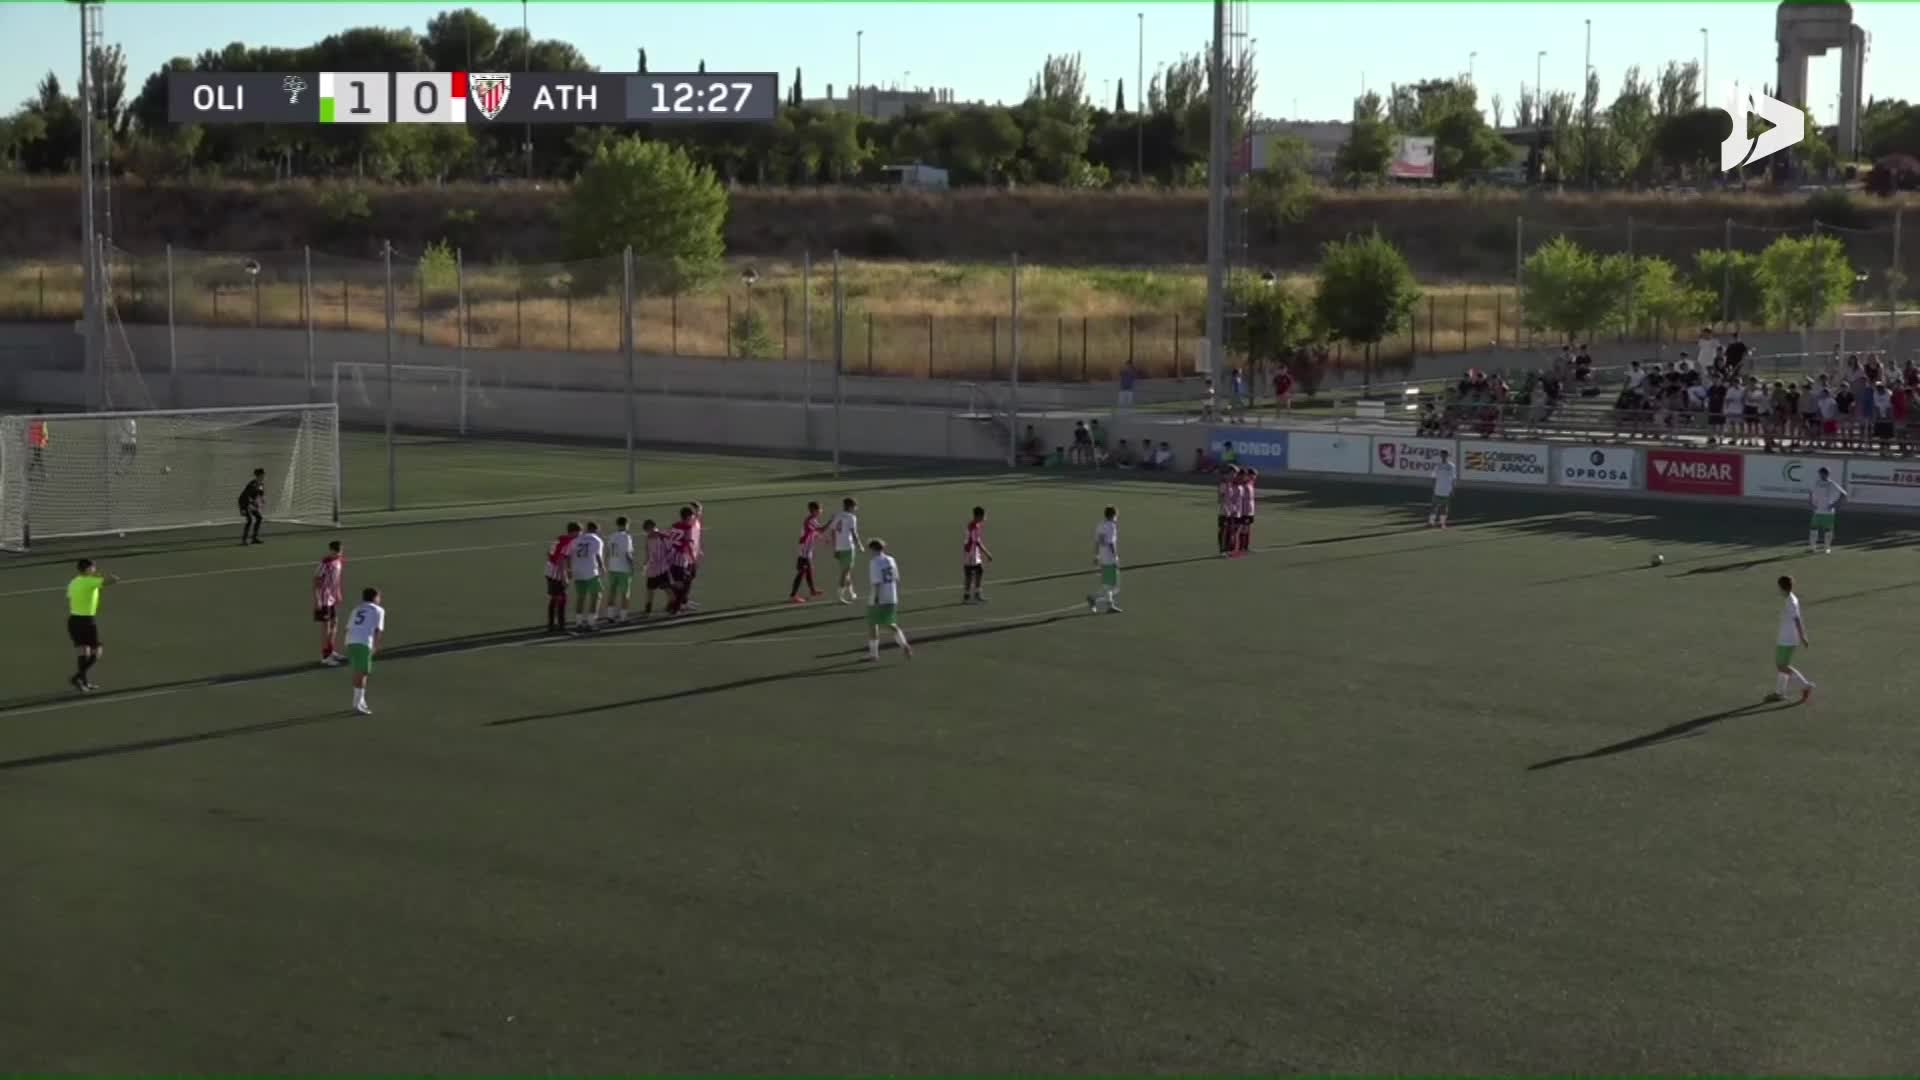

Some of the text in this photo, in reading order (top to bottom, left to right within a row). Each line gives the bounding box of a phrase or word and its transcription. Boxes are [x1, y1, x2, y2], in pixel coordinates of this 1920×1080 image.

[1484, 450, 1537, 464] GOBIERNO
[1565, 467, 1628, 481] OPROSA
[1666, 460, 1733, 482] AMBAR
[354, 610, 366, 625] 5
